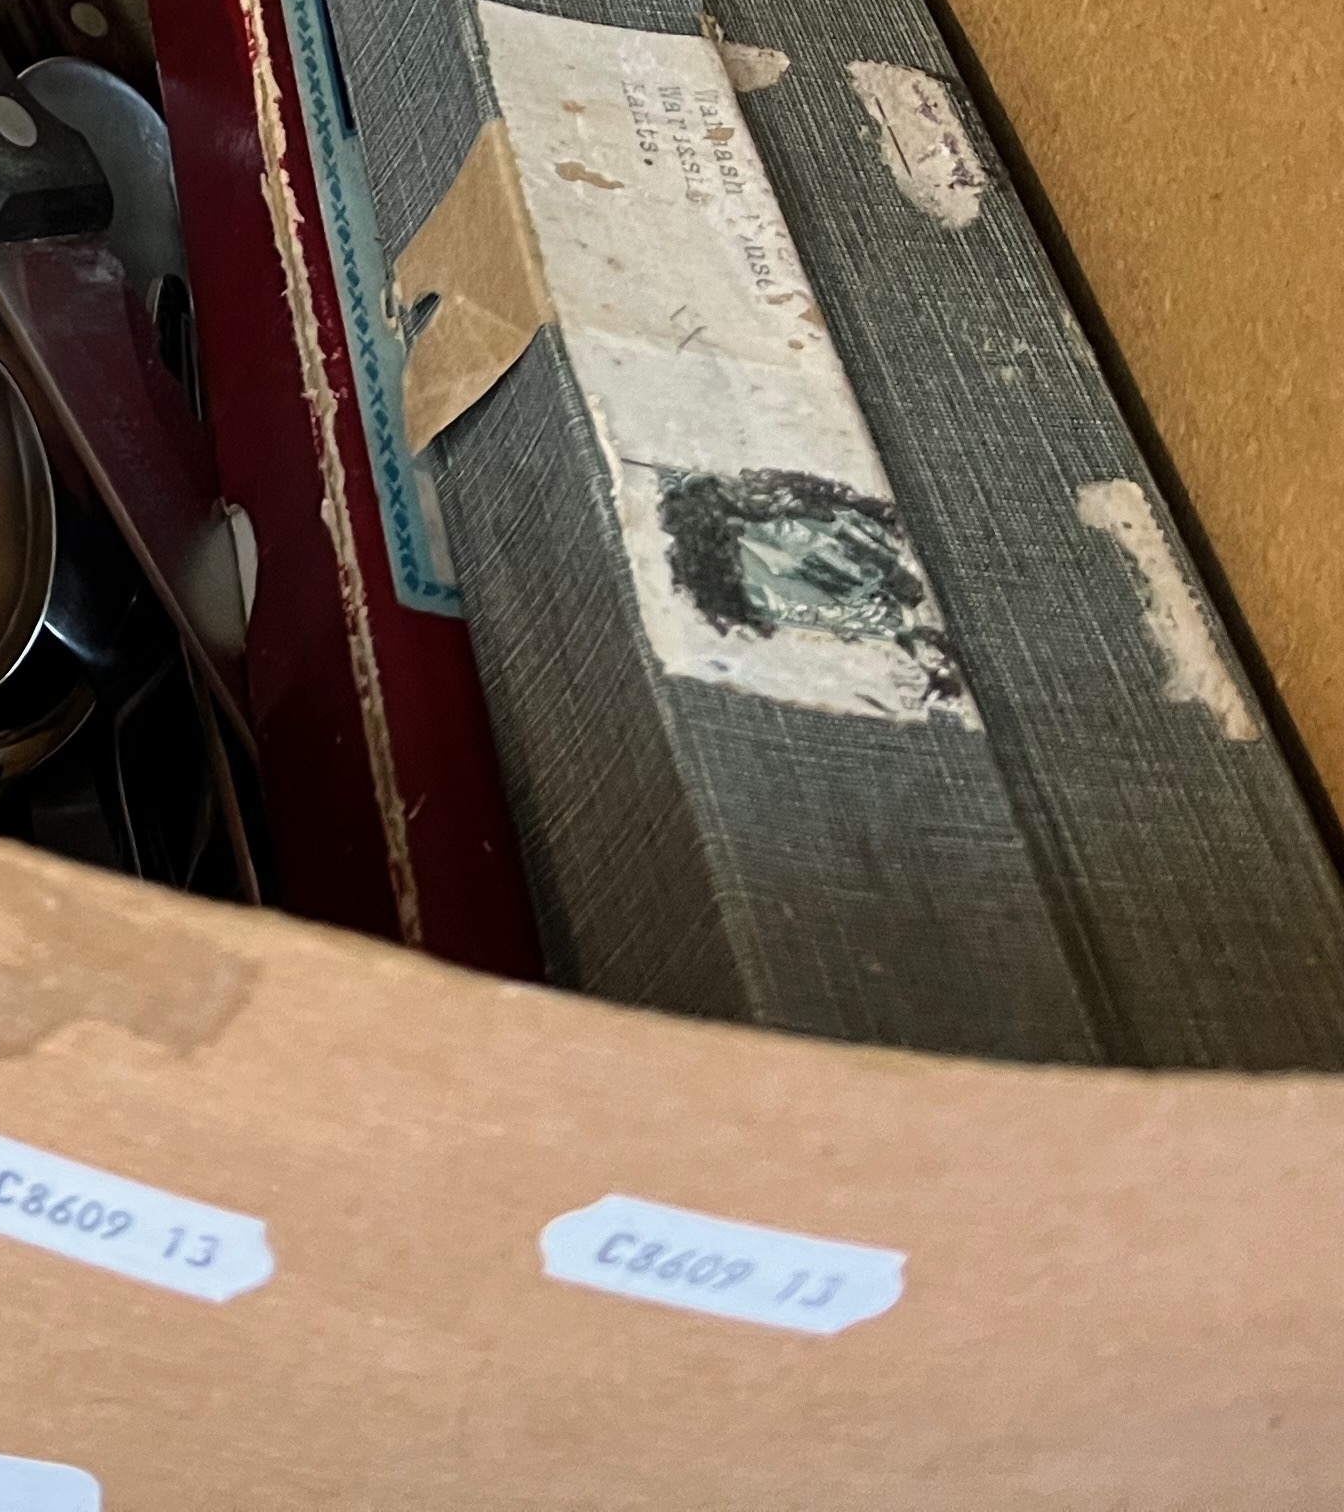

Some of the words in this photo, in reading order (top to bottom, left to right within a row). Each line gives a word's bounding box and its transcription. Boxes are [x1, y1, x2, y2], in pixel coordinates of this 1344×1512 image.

[161, 1226, 221, 1269] 13
[596, 1231, 757, 1291] C8609
[773, 1269, 848, 1308] 13
